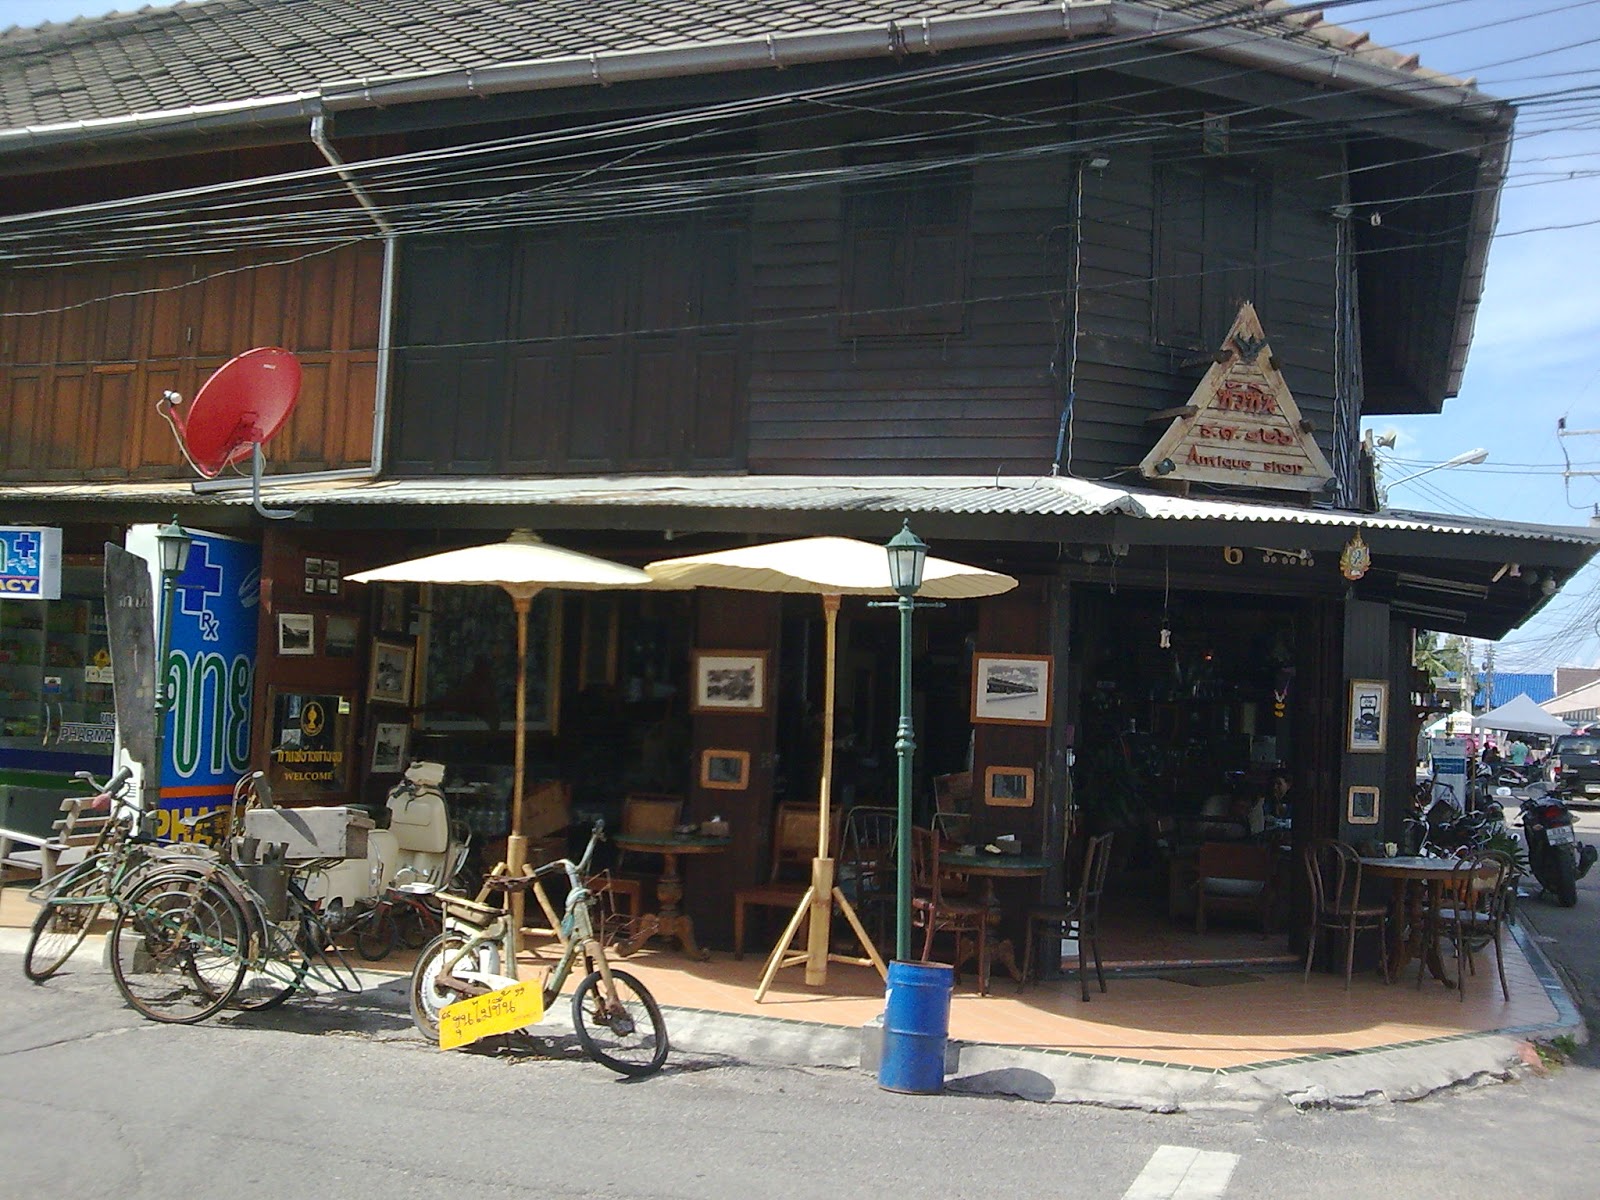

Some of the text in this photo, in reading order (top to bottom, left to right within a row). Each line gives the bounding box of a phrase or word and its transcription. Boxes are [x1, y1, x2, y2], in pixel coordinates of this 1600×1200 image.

[1186, 443, 1303, 476] Antique shop
[284, 771, 334, 781] WELCOME
